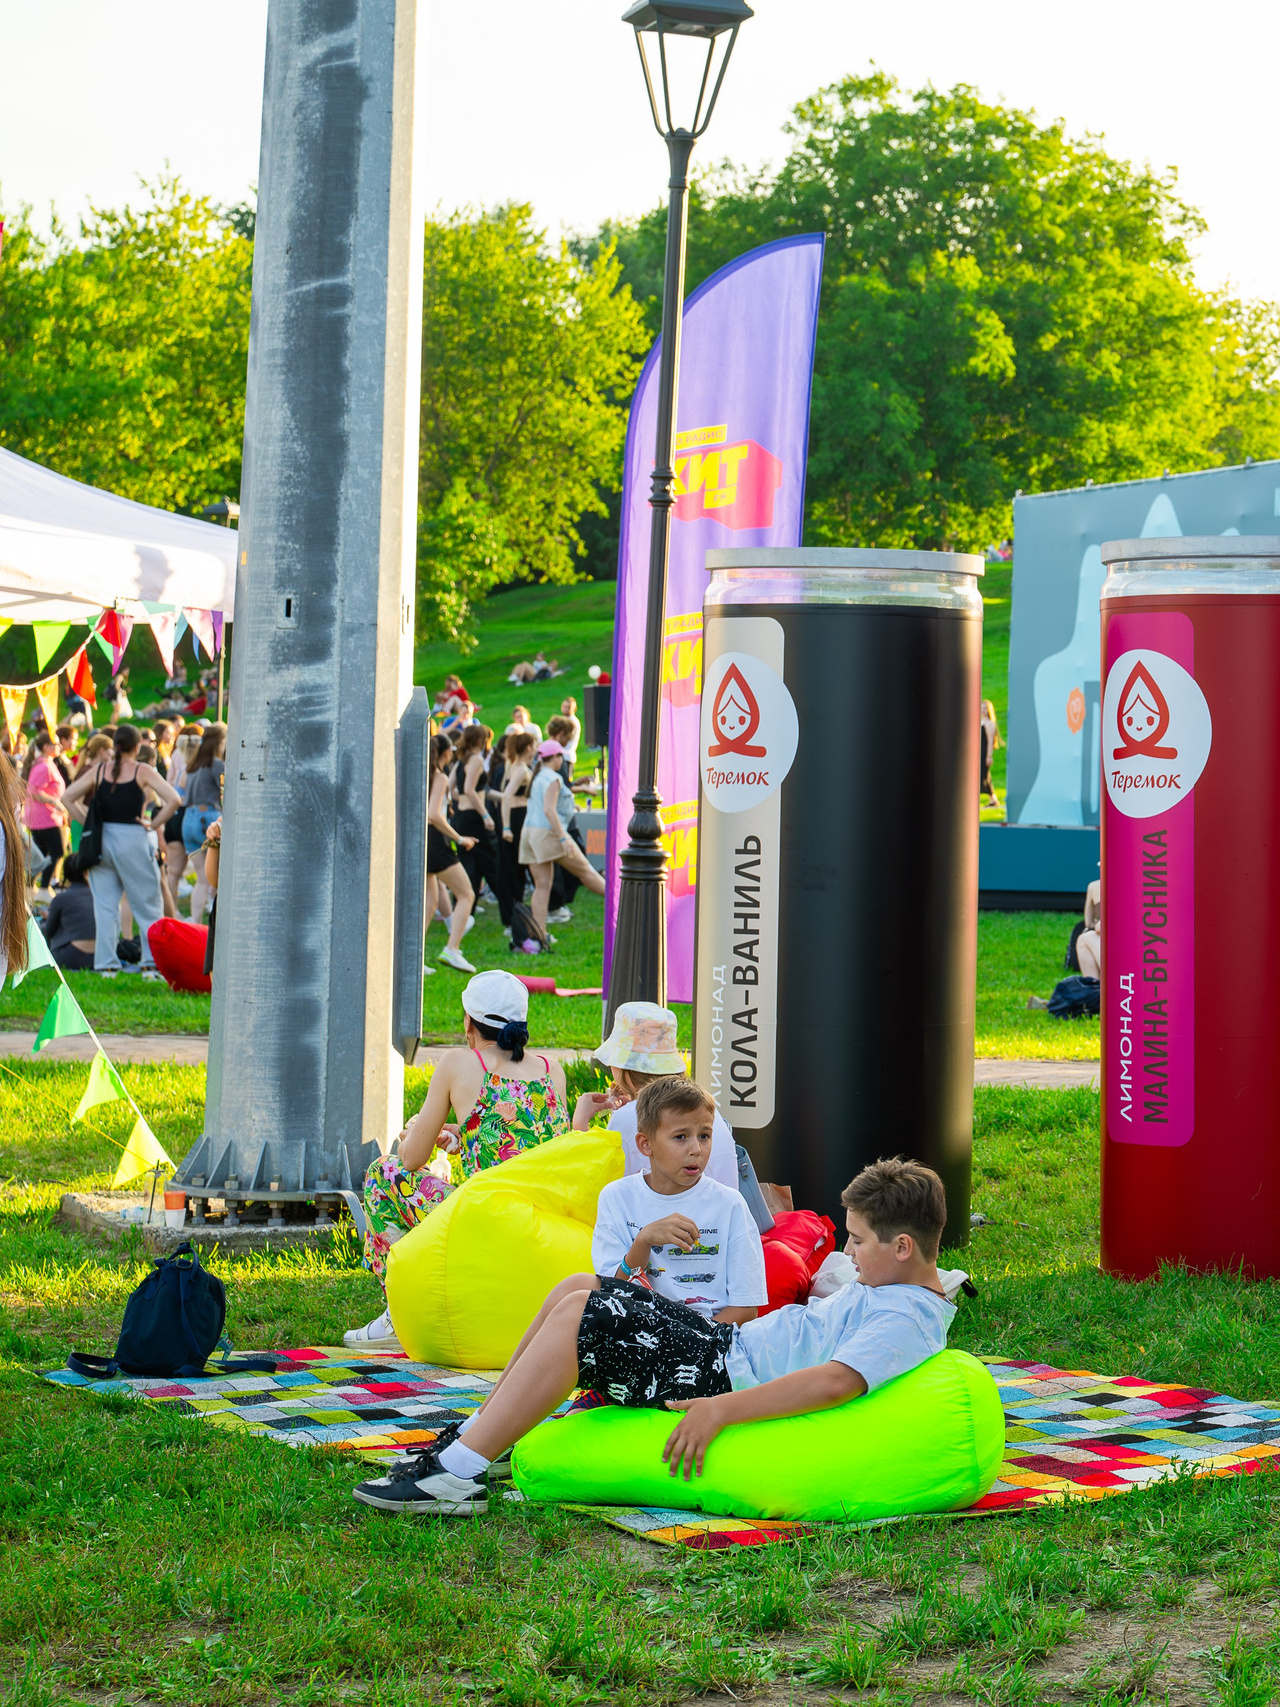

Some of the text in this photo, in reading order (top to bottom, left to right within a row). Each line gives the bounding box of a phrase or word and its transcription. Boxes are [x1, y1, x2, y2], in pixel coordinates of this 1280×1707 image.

[685, 429, 724, 444] РАДИО
[673, 615, 704, 629] РАДИ
[661, 638, 703, 684] ХИ
[706, 767, 769, 789] Теремок
[1111, 770, 1181, 793] Теремок
[730, 835, 762, 1108] КОЛА-ВАНИЛЬ
[1142, 829, 1169, 1124] МАЛИНА-БРУСНИКА
[1119, 972, 1135, 1123] ЛИМОНАД
